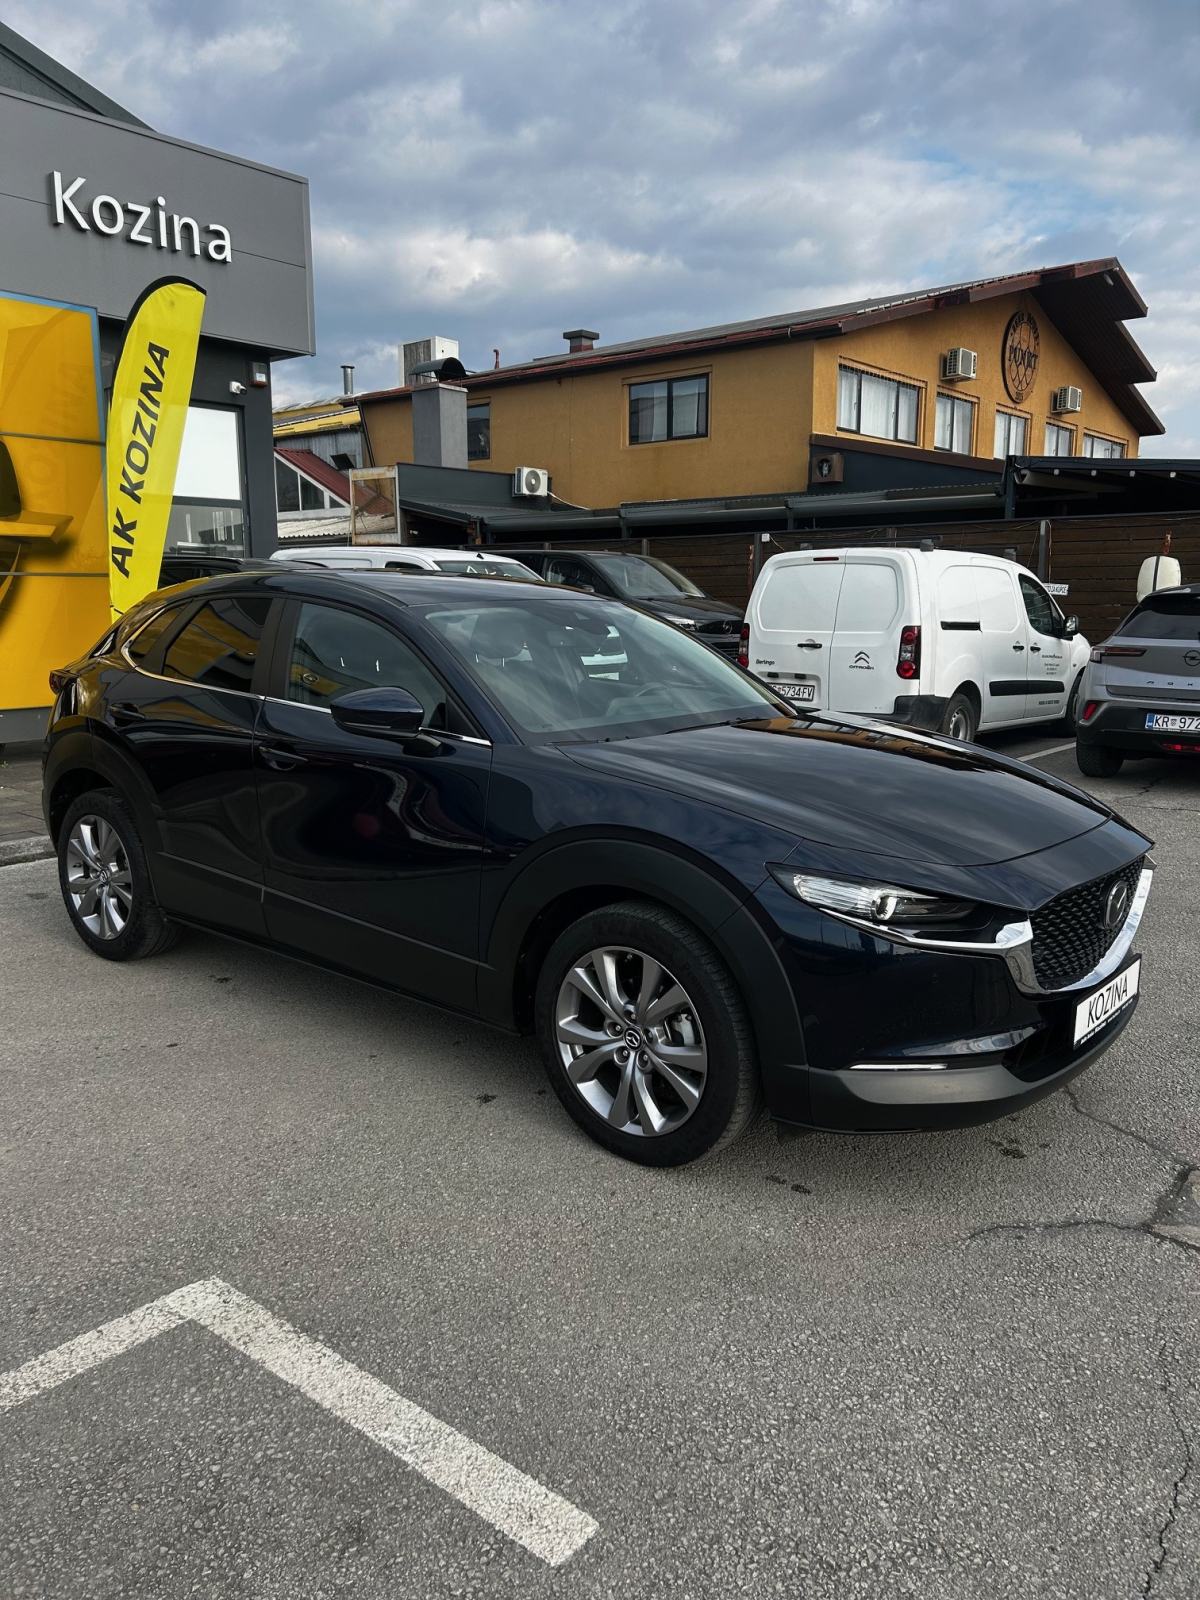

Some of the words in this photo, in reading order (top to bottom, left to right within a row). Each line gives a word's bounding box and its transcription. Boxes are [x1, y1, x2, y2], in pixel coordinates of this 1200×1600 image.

[50, 170, 232, 263] Kozina
[119, 341, 170, 504] KOZINA
[111, 507, 138, 579] AK
[755, 658, 775, 666] Berlingo
[1154, 715, 1170, 727] KR
[1087, 973, 1128, 1028] KOZINA
